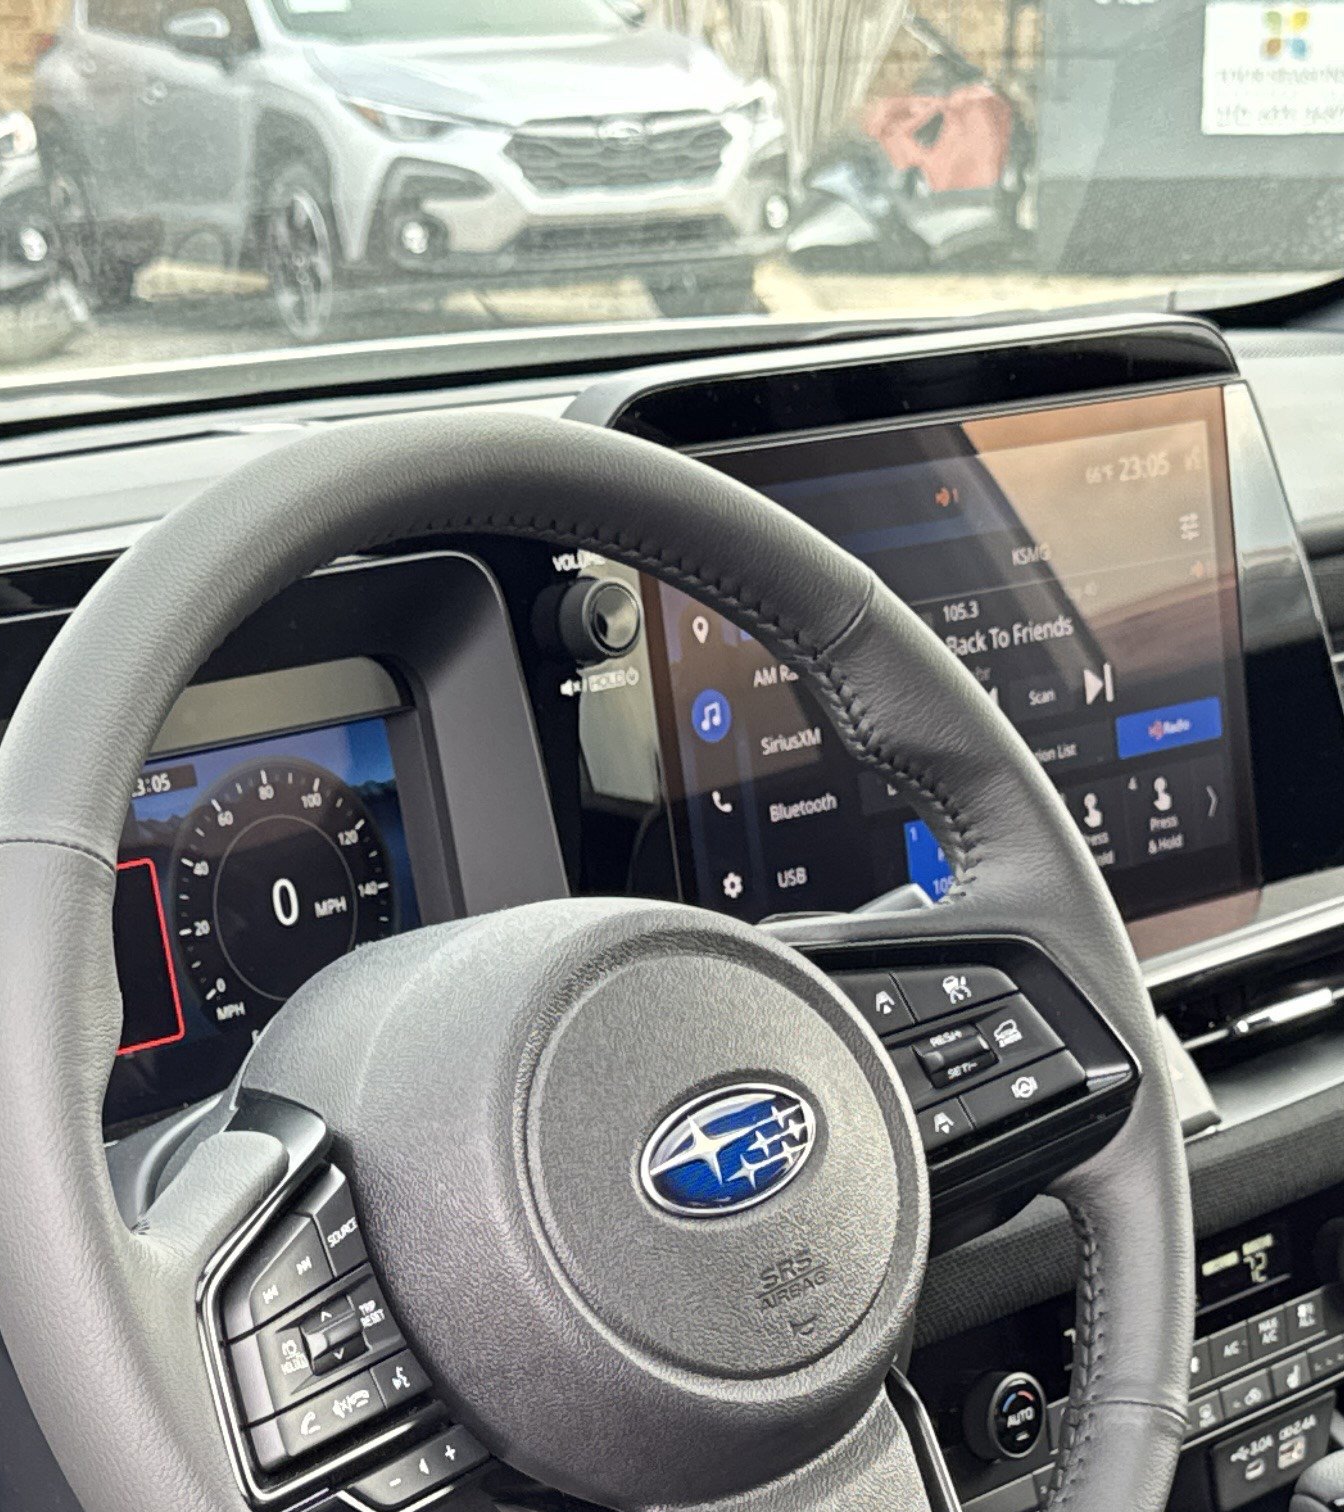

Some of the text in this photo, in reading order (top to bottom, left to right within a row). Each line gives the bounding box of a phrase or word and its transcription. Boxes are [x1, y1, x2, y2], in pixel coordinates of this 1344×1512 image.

[1118, 450, 1170, 481] 23:05
[942, 600, 979, 623] 105.3
[945, 614, 1074, 656] Back To Friends
[753, 666, 777, 688] AM
[1029, 689, 1056, 706] Scan
[760, 727, 823, 756] SiriusXM
[1057, 743, 1077, 760] List
[258, 784, 275, 801] 80
[1128, 776, 1138, 791] 4
[301, 792, 323, 810] 100
[769, 792, 838, 823] Bluetooth
[217, 810, 234, 828] 60
[1149, 815, 1179, 832] Press
[338, 829, 359, 847] 120
[909, 826, 918, 842] 1
[193, 861, 210, 877] 40
[776, 867, 808, 889] USB
[358, 880, 379, 898] 140
[272, 878, 348, 927] 0 MPH
[194, 920, 211, 937] 20
[215, 977, 227, 993] 0
[216, 1001, 247, 1021] MPH
[759, 1256, 813, 1289] SRS
[759, 1270, 829, 1312] AIRBAG
[1007, 1406, 1035, 1428] AUTO
